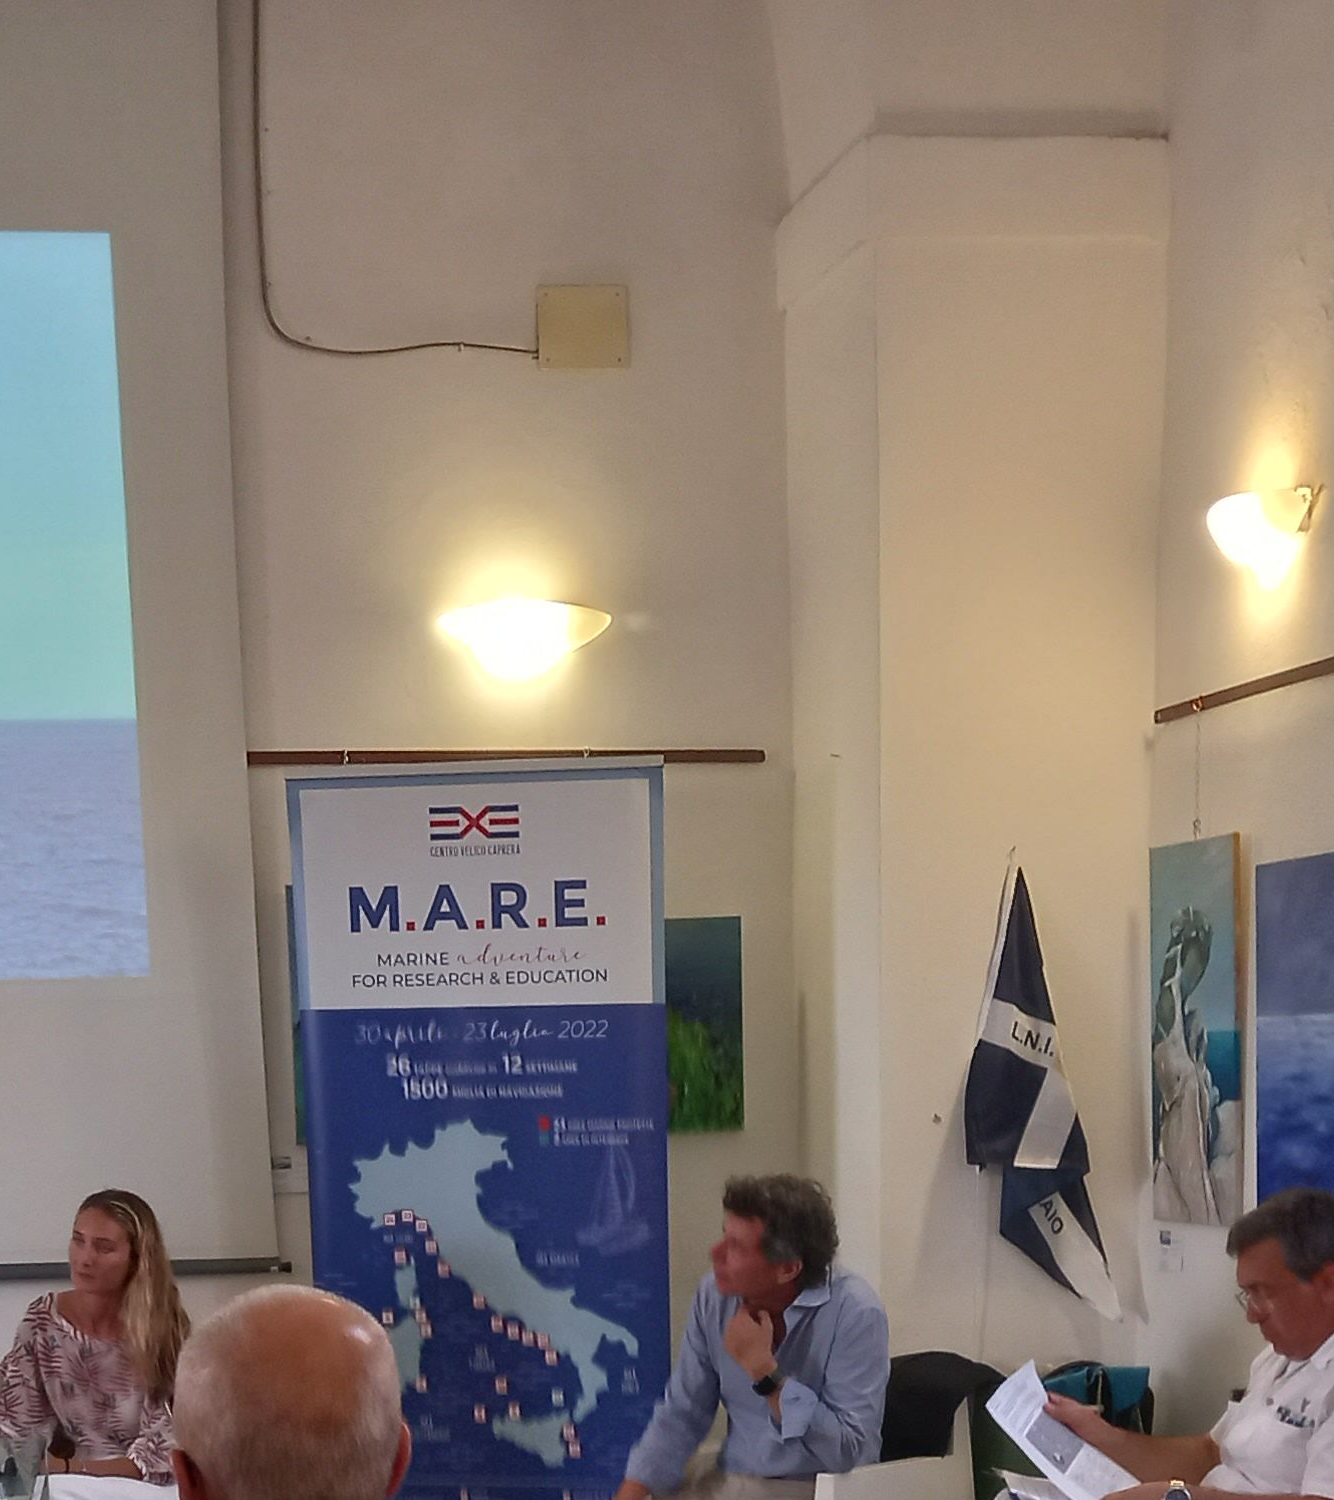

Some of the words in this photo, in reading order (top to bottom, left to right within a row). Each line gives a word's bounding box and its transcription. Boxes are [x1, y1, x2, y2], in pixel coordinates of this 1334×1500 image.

[430, 846, 459, 858] CENTRO
[488, 843, 521, 856] CAPRERA
[348, 879, 607, 933] M.A.R.E.
[378, 951, 449, 967] MARINE
[457, 942, 586, 966] adventure
[352, 973, 387, 989] FOR
[392, 971, 484, 988] RESEARCH
[489, 972, 501, 986] &
[506, 968, 609, 985] EDUCATION
[463, 1022, 486, 1042] 23
[557, 1019, 609, 1039] 2022
[1011, 1020, 1054, 1057] L.N.I.
[502, 1053, 524, 1075] 12
